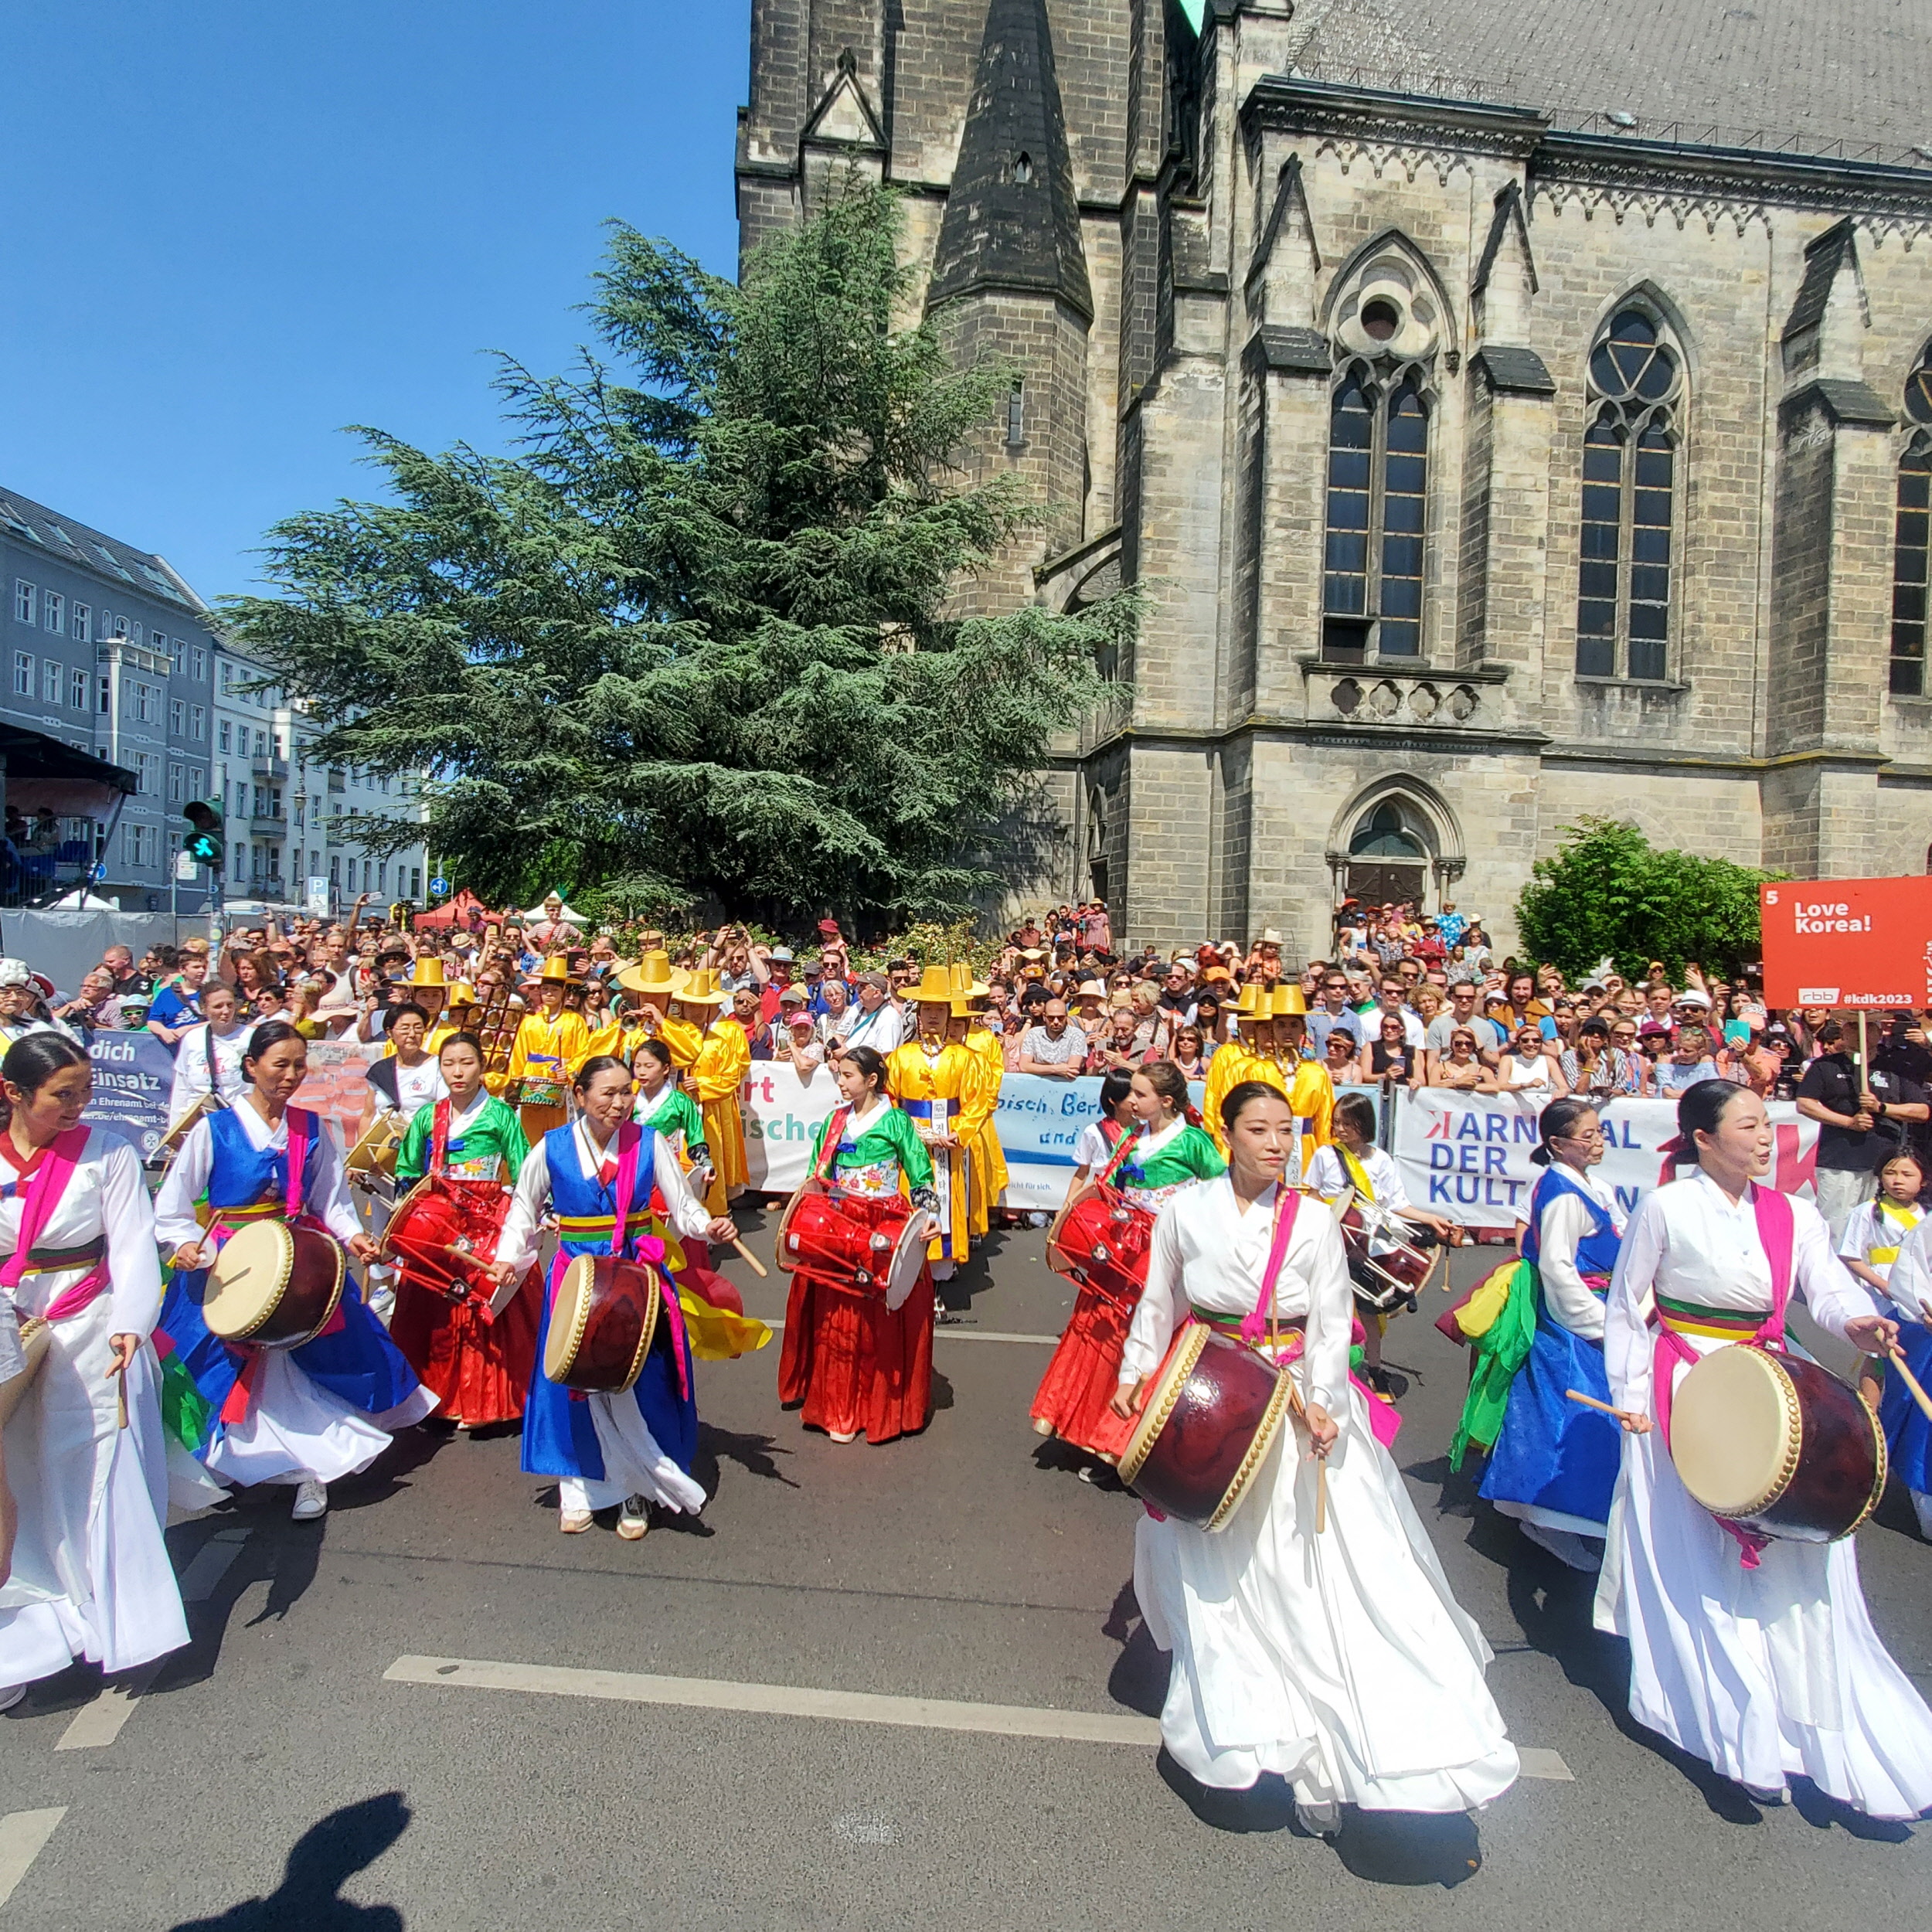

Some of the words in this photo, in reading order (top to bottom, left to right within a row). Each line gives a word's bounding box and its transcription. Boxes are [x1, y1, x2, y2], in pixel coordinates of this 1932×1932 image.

[313, 879, 323, 893] P
[1765, 890, 1778, 905] 5
[1794, 902, 1849, 918] Love
[1794, 915, 1872, 934] Korea!
[1802, 992, 1834, 1001] rbb
[1843, 994, 1913, 1005] #kdk2023
[90, 1039, 135, 1062] dich
[736, 1077, 775, 1104] rt
[99, 1097, 143, 1108] Ehrenamt
[740, 1110, 824, 1141] ische
[1430, 1143, 1507, 1175] DER
